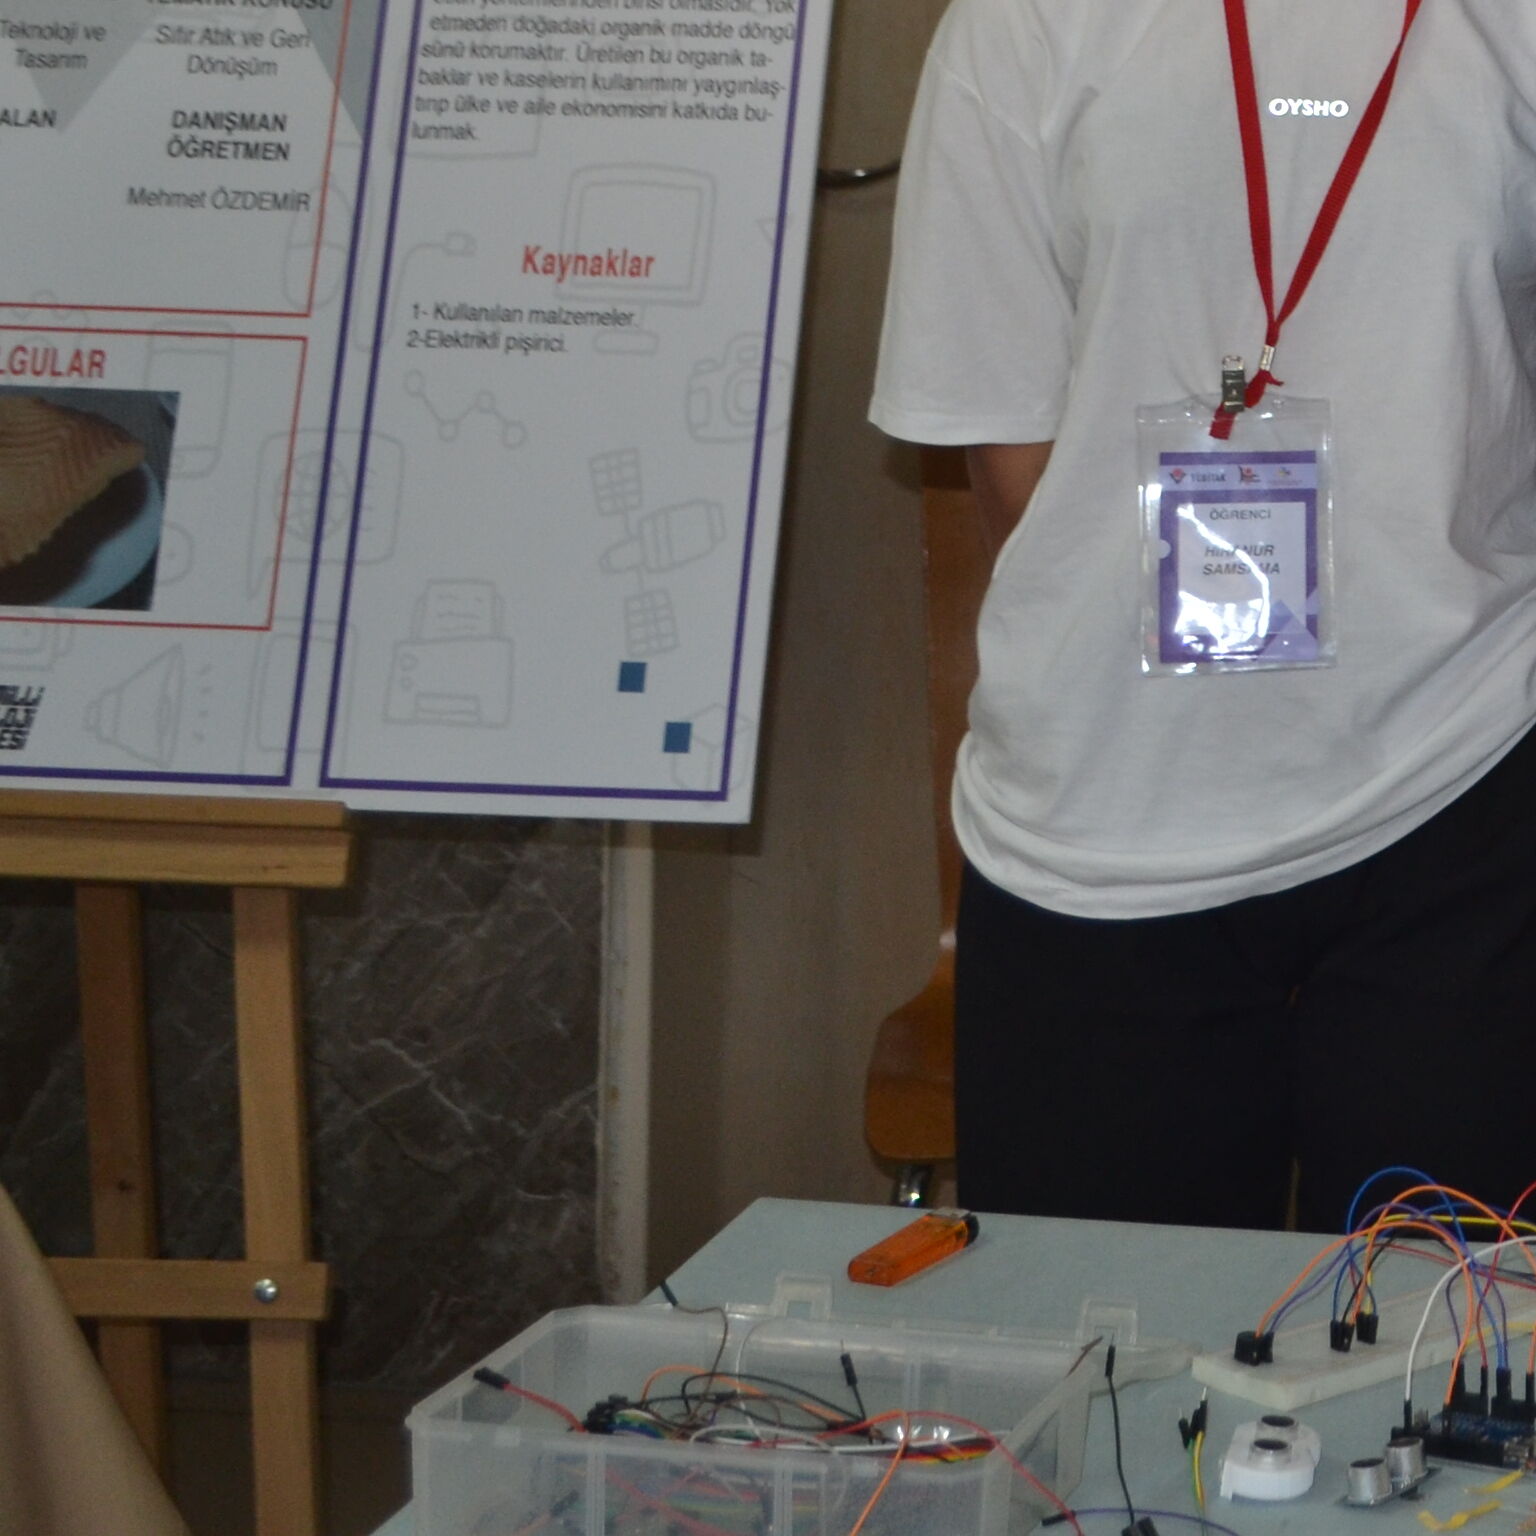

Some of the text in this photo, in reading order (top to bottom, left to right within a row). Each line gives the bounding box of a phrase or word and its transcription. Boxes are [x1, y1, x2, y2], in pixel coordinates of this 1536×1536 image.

[1268, 98, 1349, 118] OYSHO
[172, 110, 287, 134] DANIŞMAN
[167, 135, 290, 161] ÖĞRETMEN
[521, 244, 655, 284] Kaynaklar
